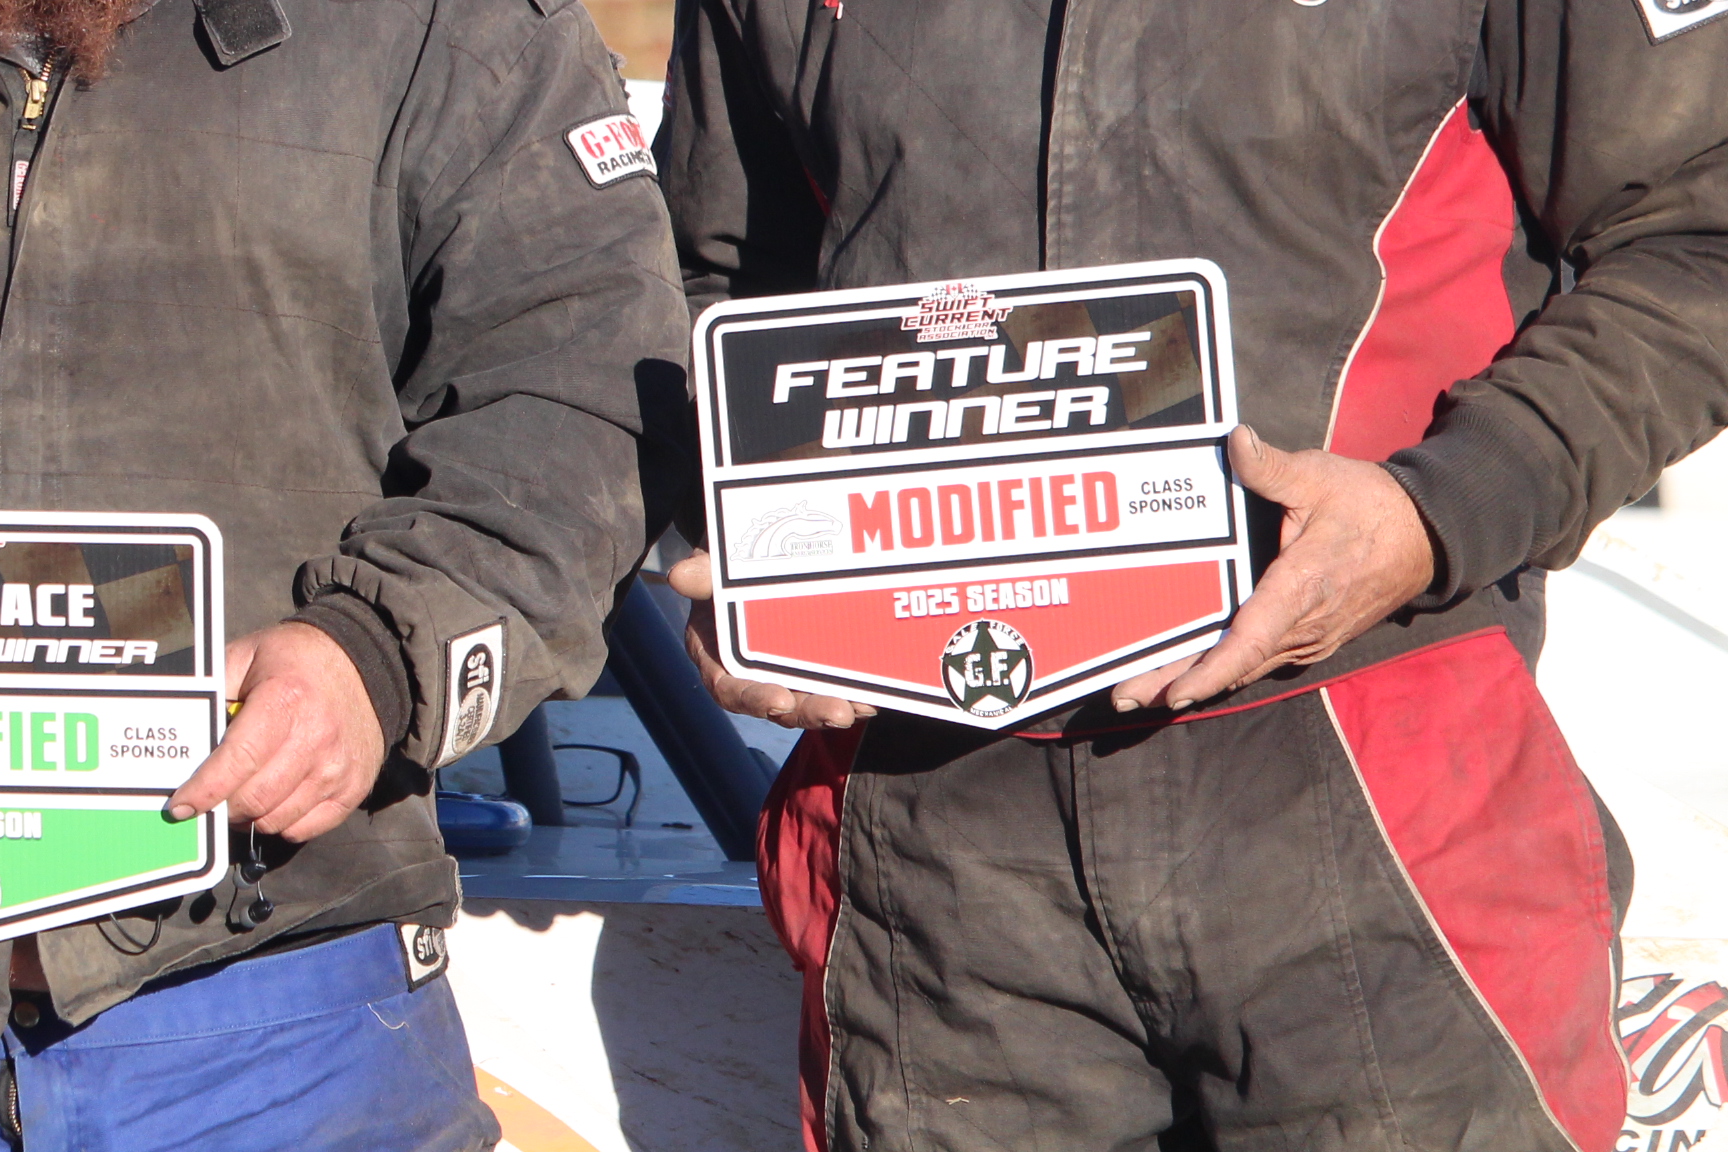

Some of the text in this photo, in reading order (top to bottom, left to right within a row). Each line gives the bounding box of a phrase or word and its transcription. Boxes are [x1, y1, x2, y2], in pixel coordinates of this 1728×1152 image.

[597, 149, 654, 175] RACIN
[920, 296, 993, 314] SWIFT
[903, 307, 1012, 328] CURRENT
[919, 328, 995, 341] ASSOCIATION
[772, 331, 1152, 404] FEATURE
[821, 385, 1110, 449] WINNER
[1141, 477, 1193, 495] CLASS
[847, 470, 1120, 554] MODIFIED
[1128, 495, 1207, 515] SPONSOR
[893, 578, 1070, 619] 2025 SEASON
[123, 727, 178, 741] CLASS
[110, 744, 190, 759] SPONSOR
